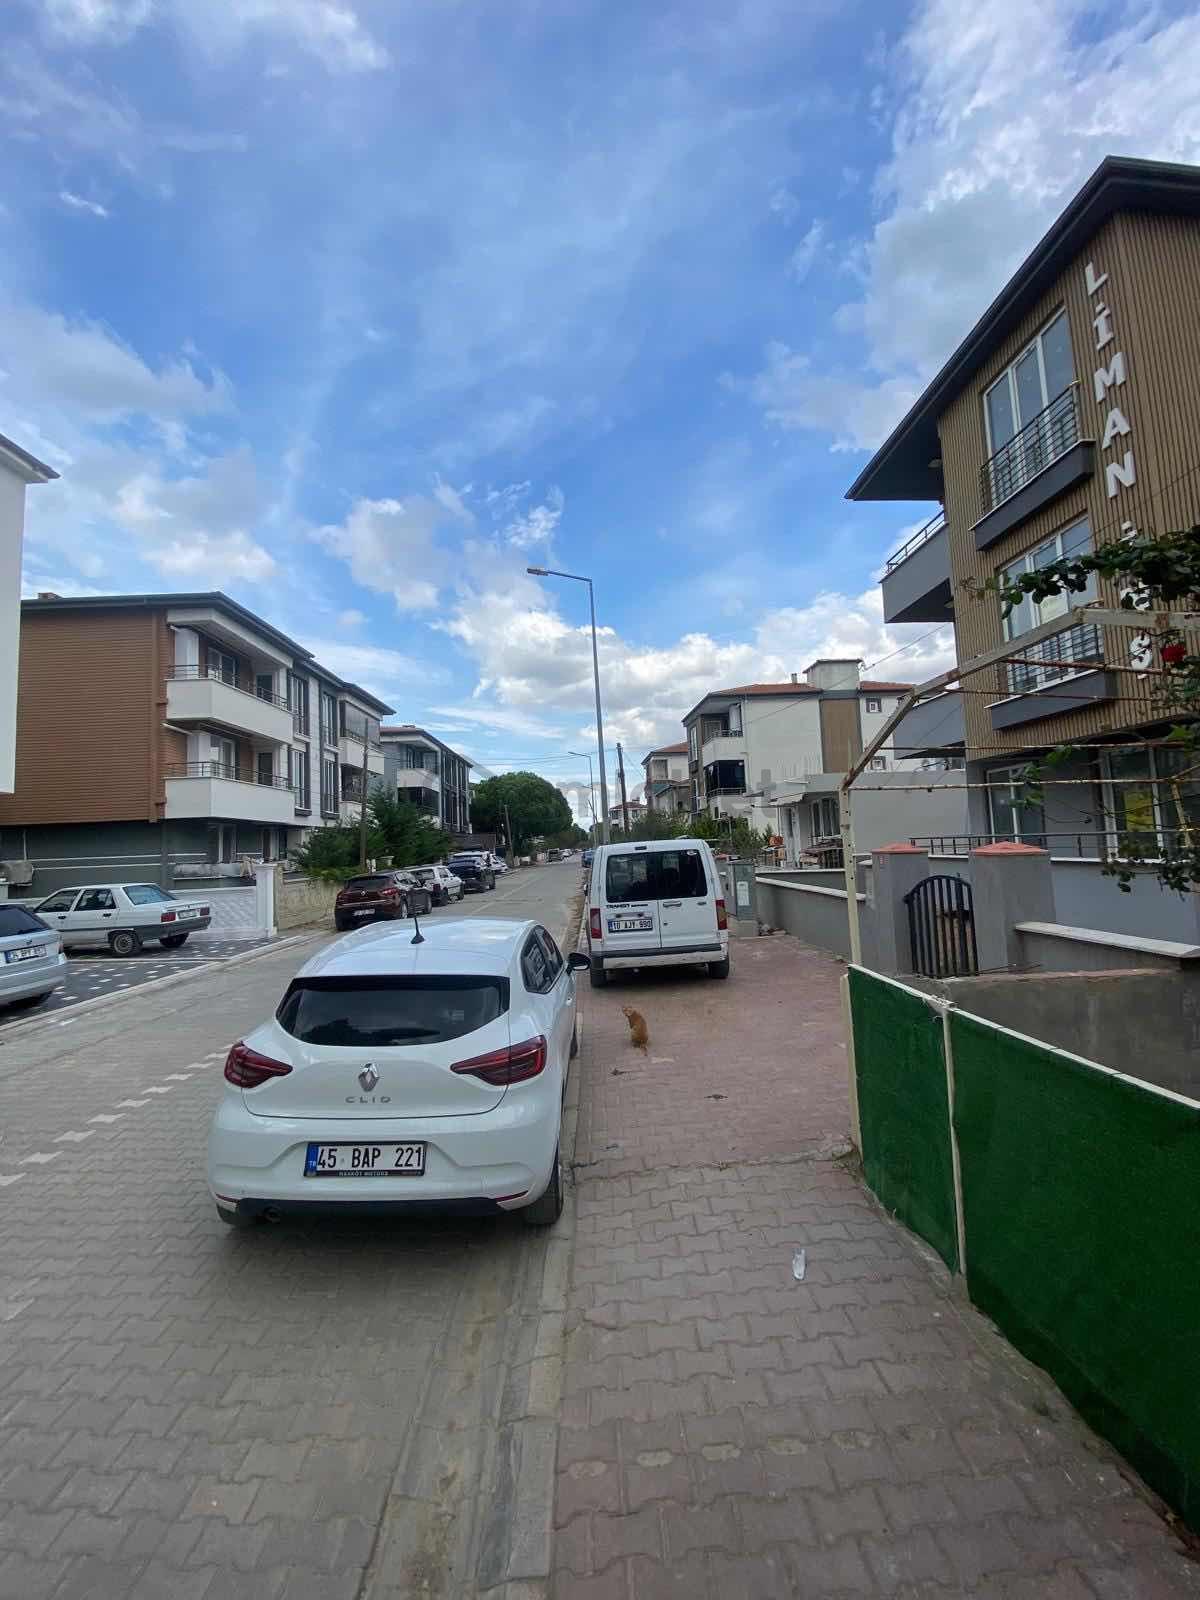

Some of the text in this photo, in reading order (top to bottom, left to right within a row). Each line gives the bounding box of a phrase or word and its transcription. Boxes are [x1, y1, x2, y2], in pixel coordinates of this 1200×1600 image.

[318, 1148, 338, 1168] 45
[351, 1147, 381, 1168] BAP
[394, 1146, 422, 1168] 221
